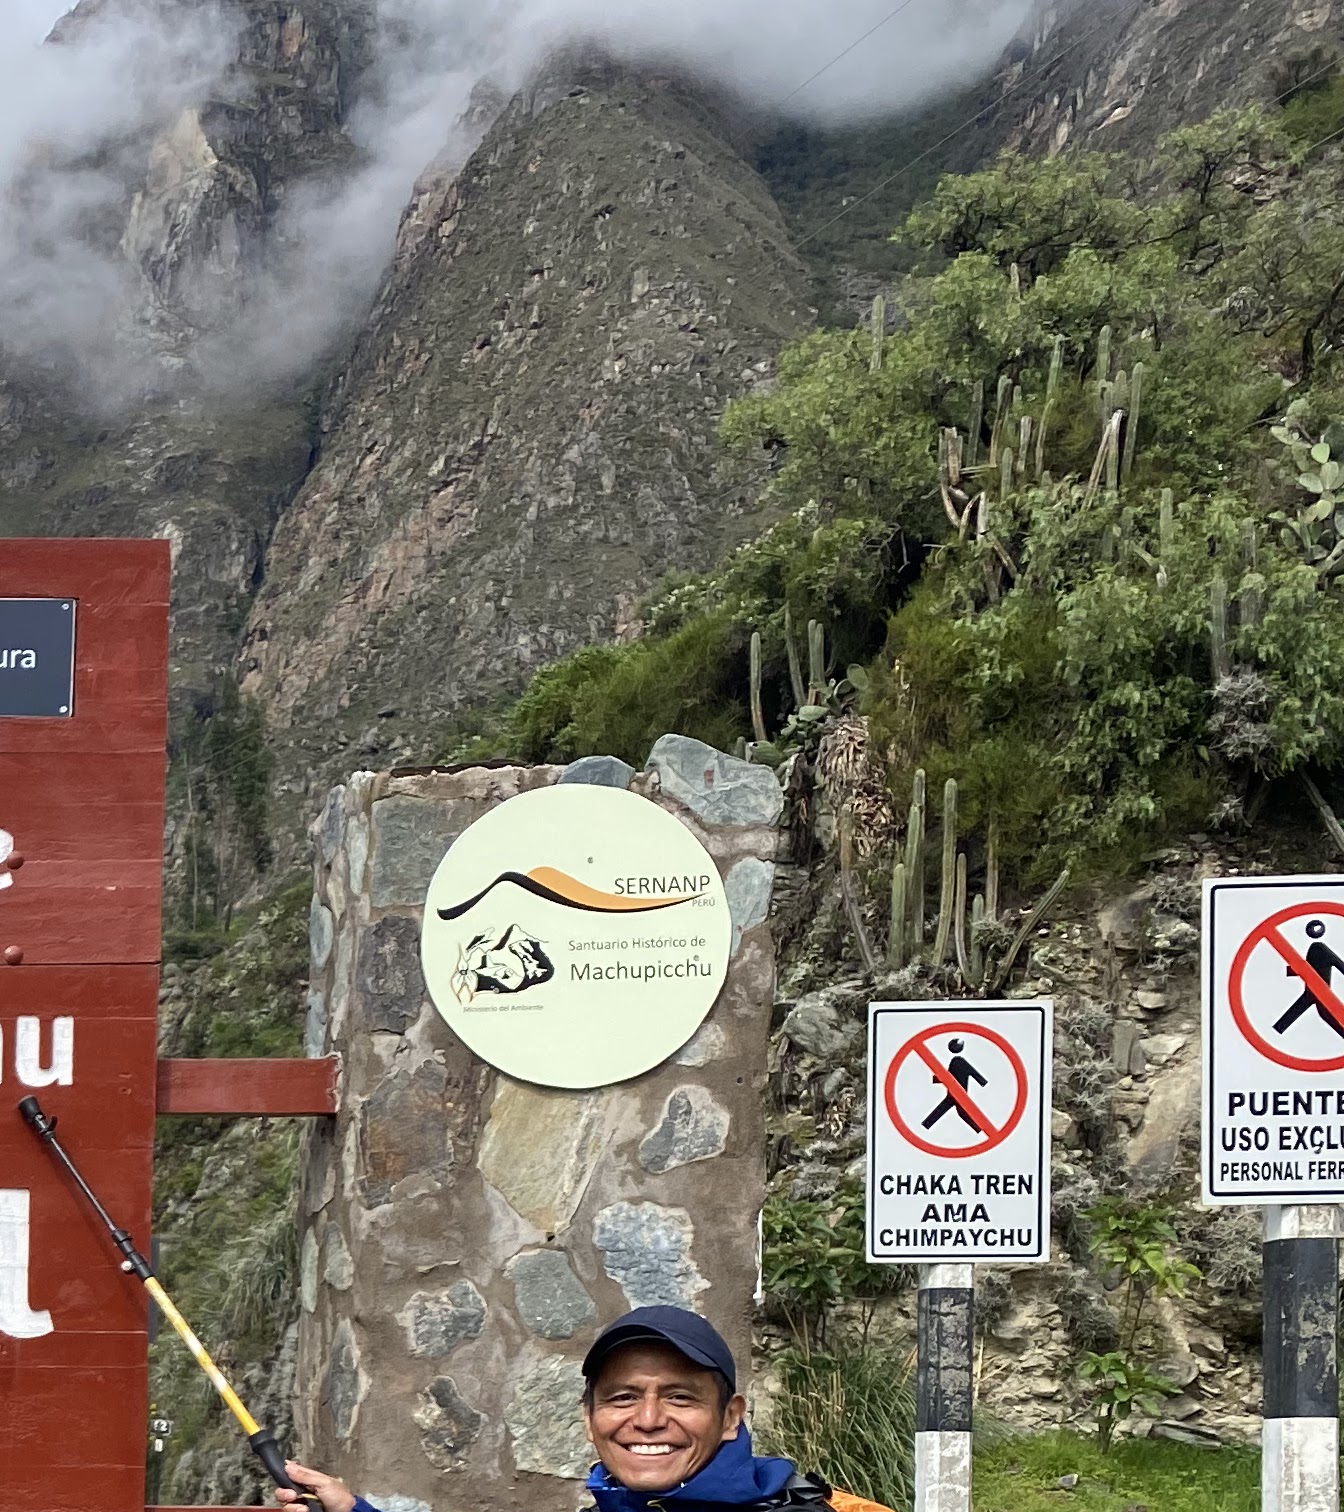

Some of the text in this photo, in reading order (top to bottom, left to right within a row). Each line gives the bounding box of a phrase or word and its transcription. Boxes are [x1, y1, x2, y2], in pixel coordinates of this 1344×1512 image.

[614, 875, 711, 895] SERNANP
[692, 897, 716, 907] PERÚ
[568, 936, 706, 952] Santuario Histórico de
[570, 958, 712, 983] Machupicchu
[1221, 1126, 1344, 1152] USO EXCL
[1220, 1161, 1304, 1182] PERSONAL
[880, 1174, 1033, 1195] CHAKA TREN
[920, 1203, 991, 1223] AMA
[879, 1228, 1032, 1247] CHIMPAYCHU
